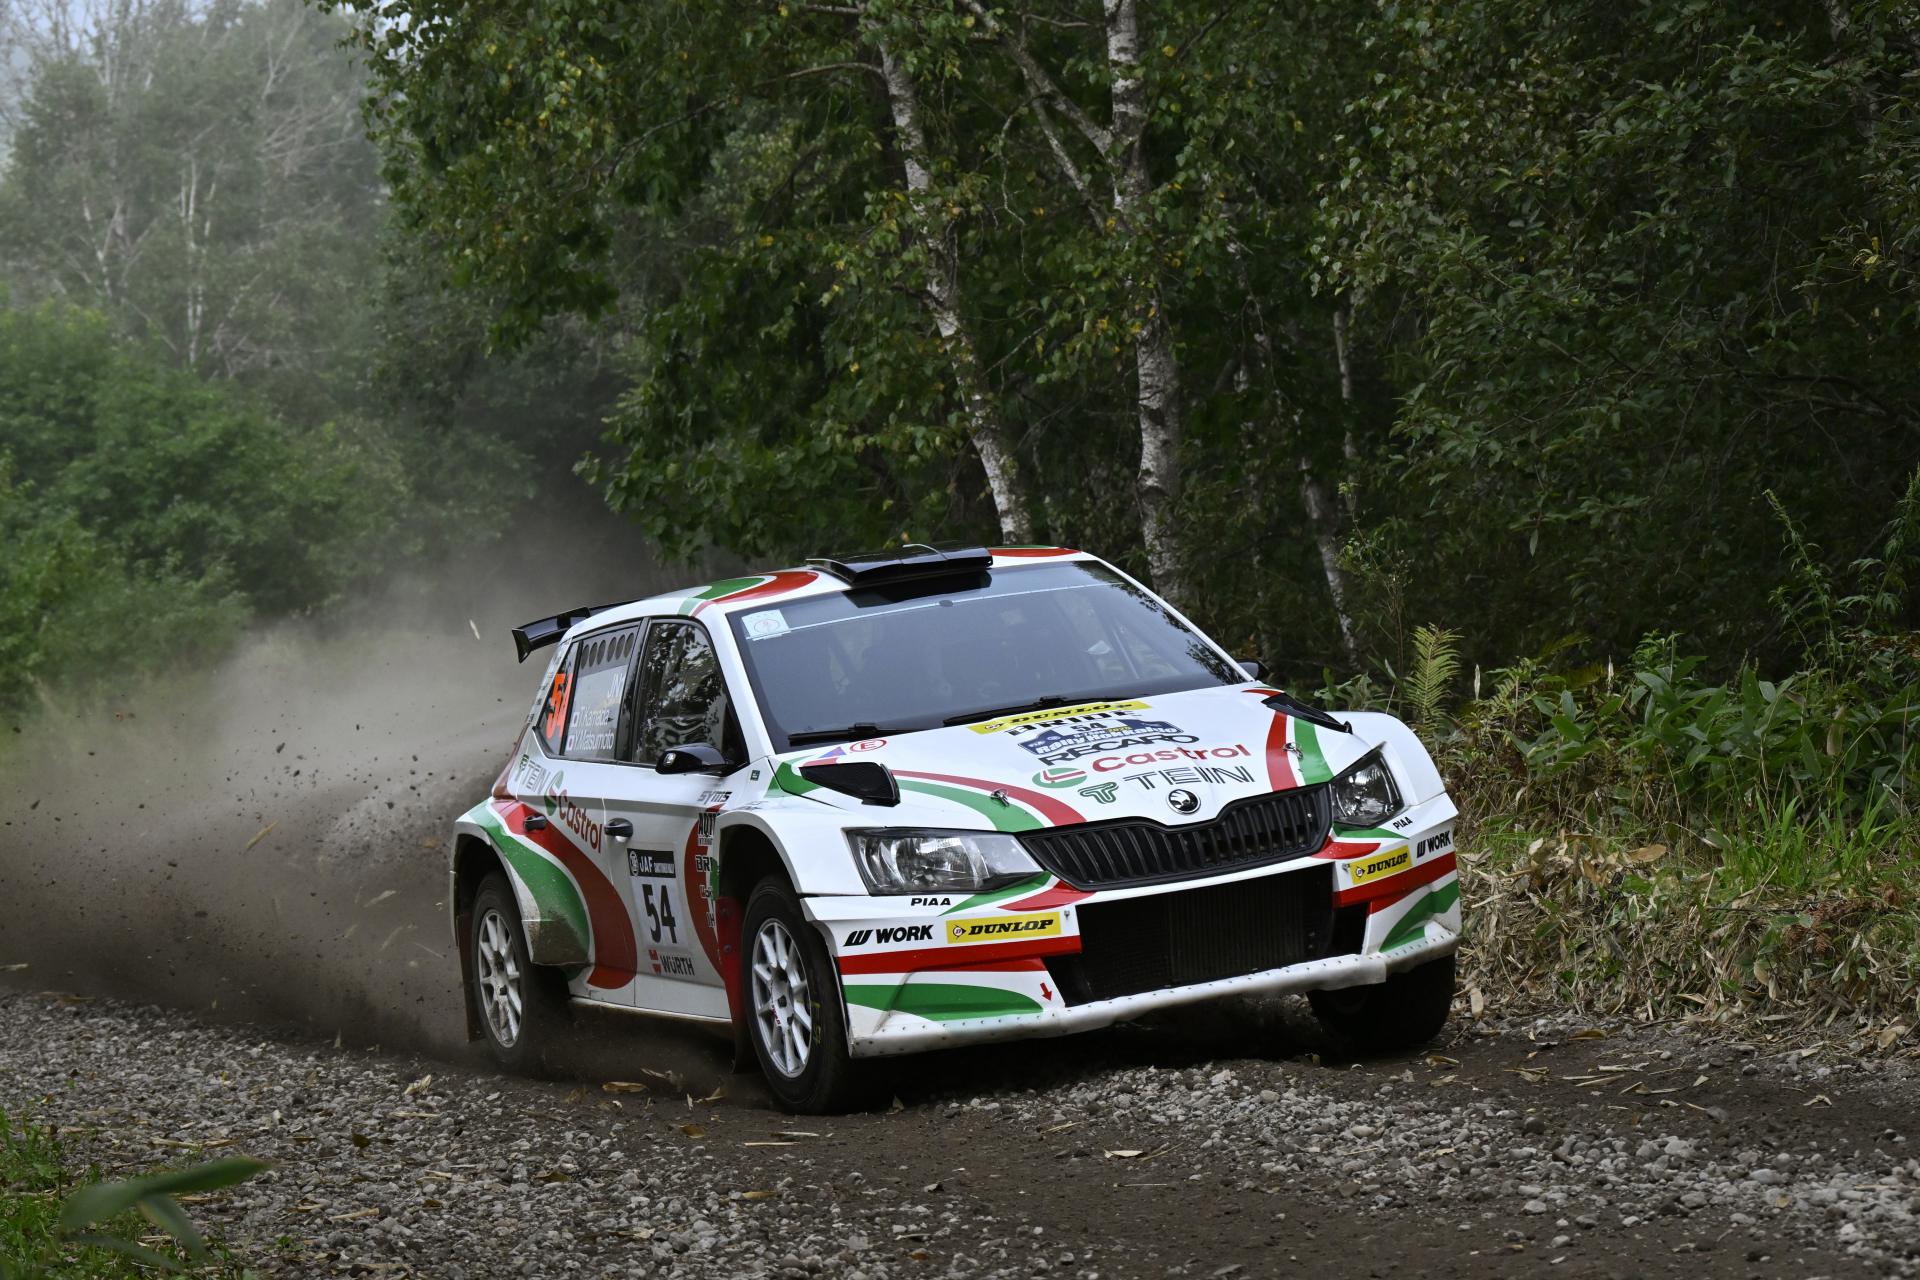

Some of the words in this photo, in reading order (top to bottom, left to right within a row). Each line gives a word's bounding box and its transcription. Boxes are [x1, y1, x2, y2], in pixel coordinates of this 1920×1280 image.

[1005, 710, 1143, 736] BRIDE
[1009, 703, 1134, 722] DUNLOP
[1071, 722, 1108, 733] 54
[1037, 734, 1200, 767] RECARO
[1091, 744, 1252, 774] Castrol
[1123, 765, 1256, 791] TEIN
[559, 789, 603, 854] Castrol
[1393, 816, 1413, 830] PIAA
[1427, 831, 1451, 852] WORK
[639, 855, 653, 873] JAF
[1366, 853, 1408, 874] DUNLOP
[910, 897, 951, 907] PIAA
[642, 883, 677, 944] 54
[876, 924, 934, 944] WORK
[968, 919, 1054, 936] DUNLOP
